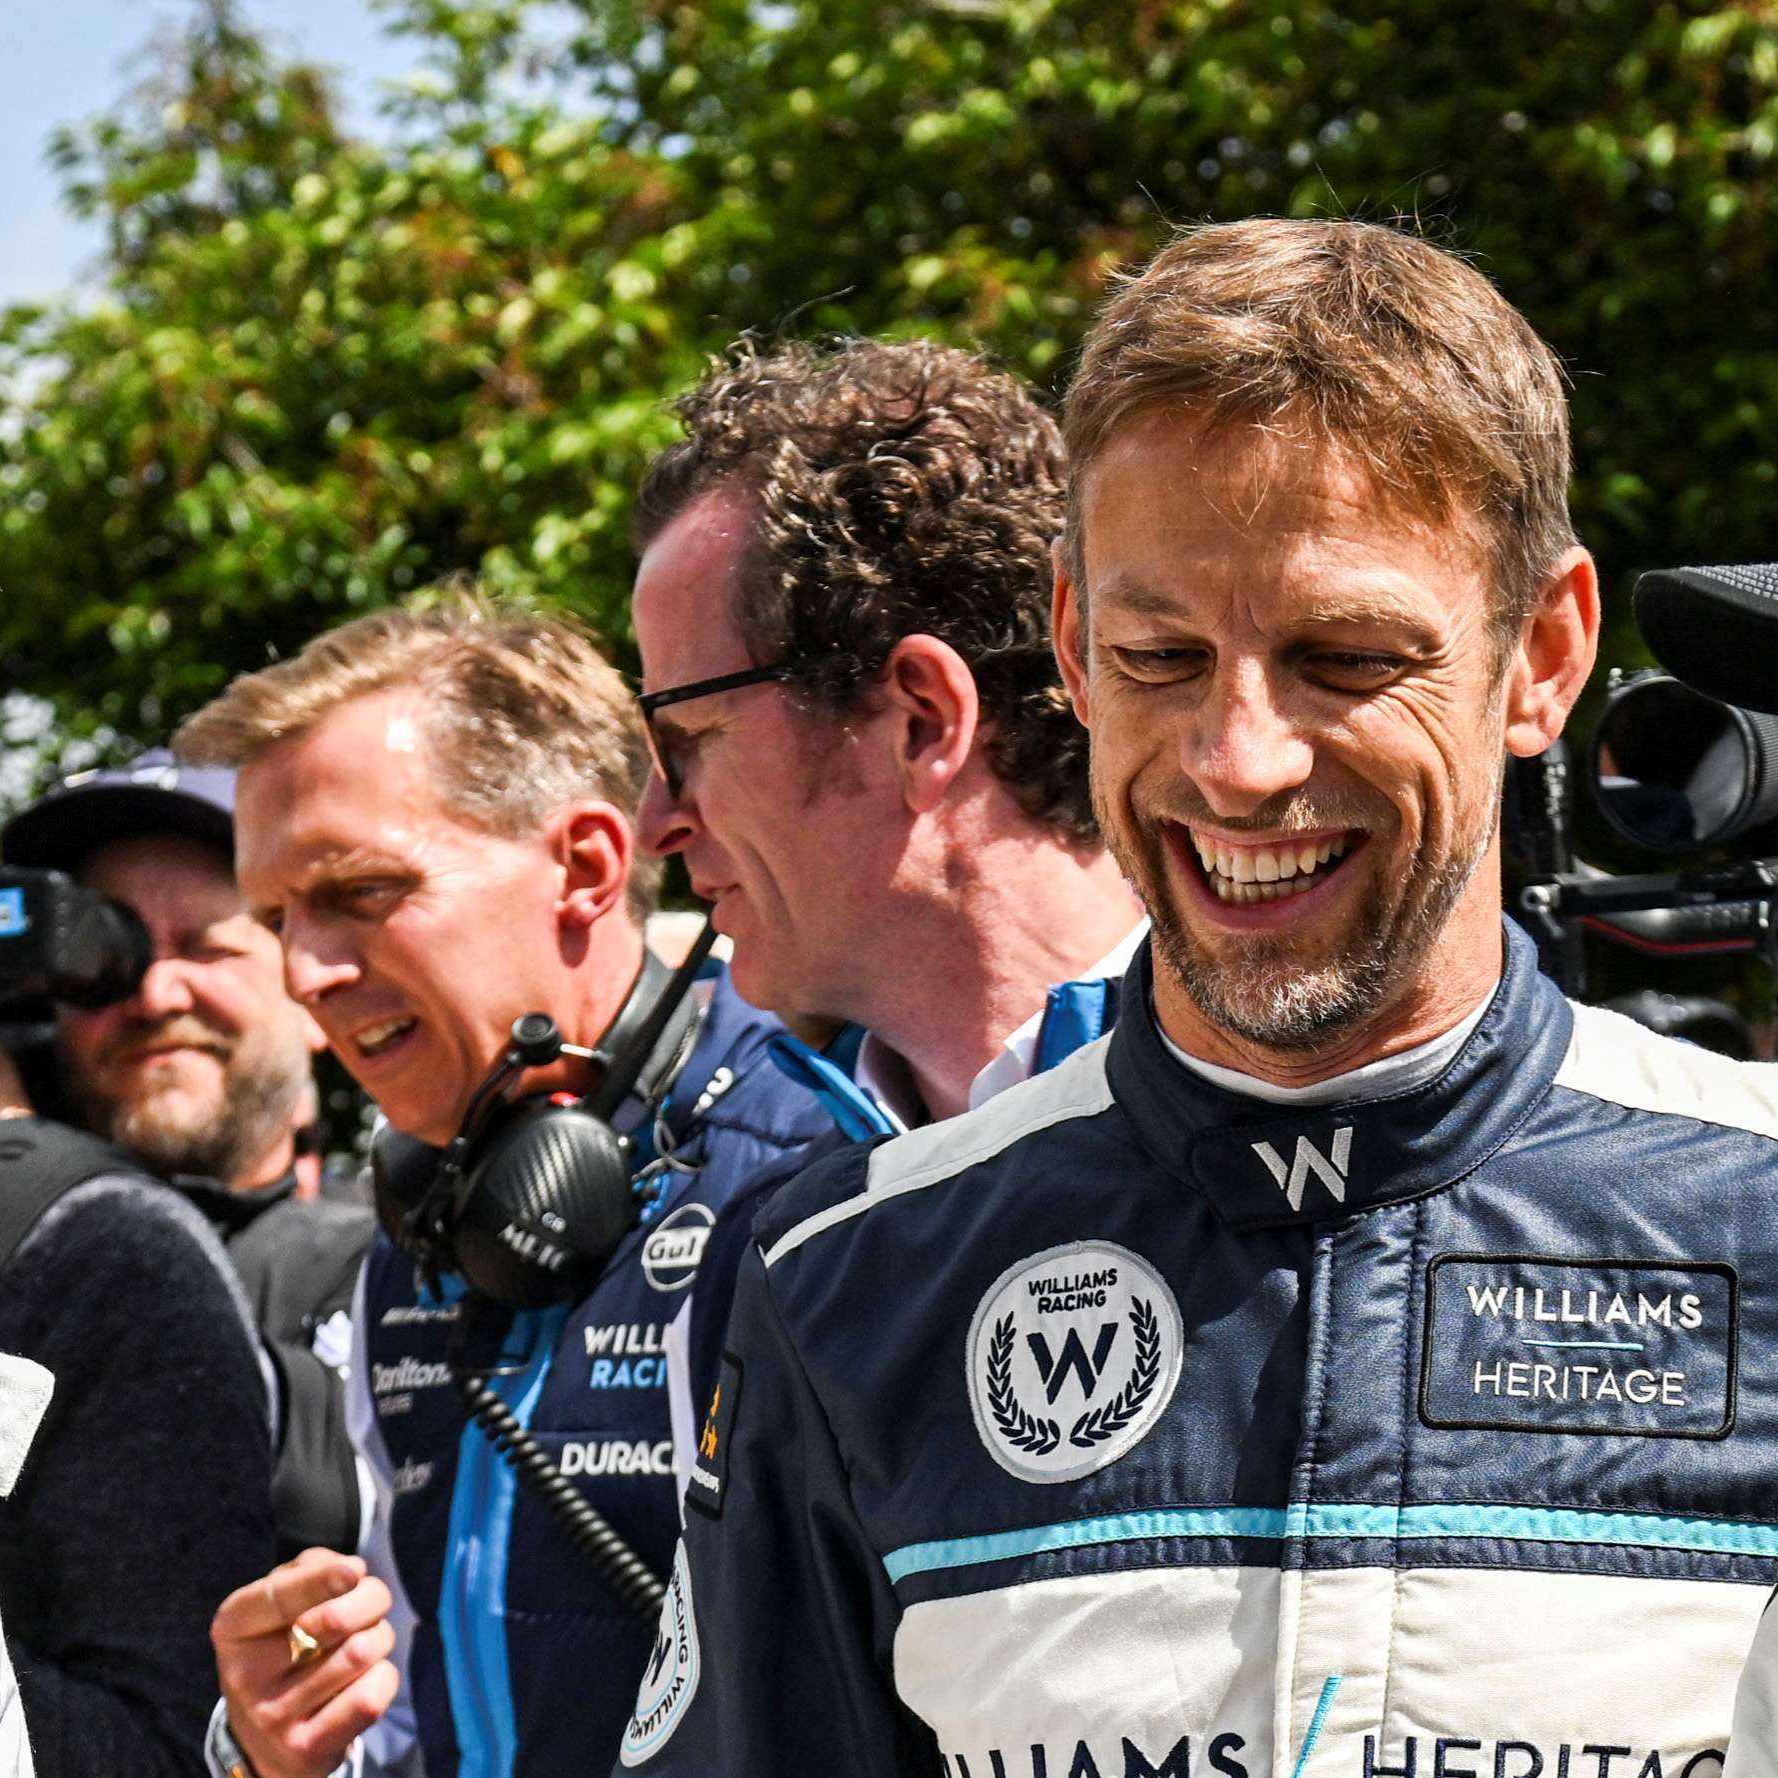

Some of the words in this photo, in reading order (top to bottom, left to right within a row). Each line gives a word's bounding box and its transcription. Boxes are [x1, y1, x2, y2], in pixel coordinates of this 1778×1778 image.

[1251, 1126, 1353, 1212] W
[1027, 1268, 1118, 1297] WILLIAMS
[1037, 1288, 1107, 1315] RACING
[1465, 1284, 1703, 1330] WILLIAMS
[1026, 1322, 1119, 1406] W
[1473, 1359, 1686, 1408] HERITAGE
[559, 1440, 677, 1477] DURAC
